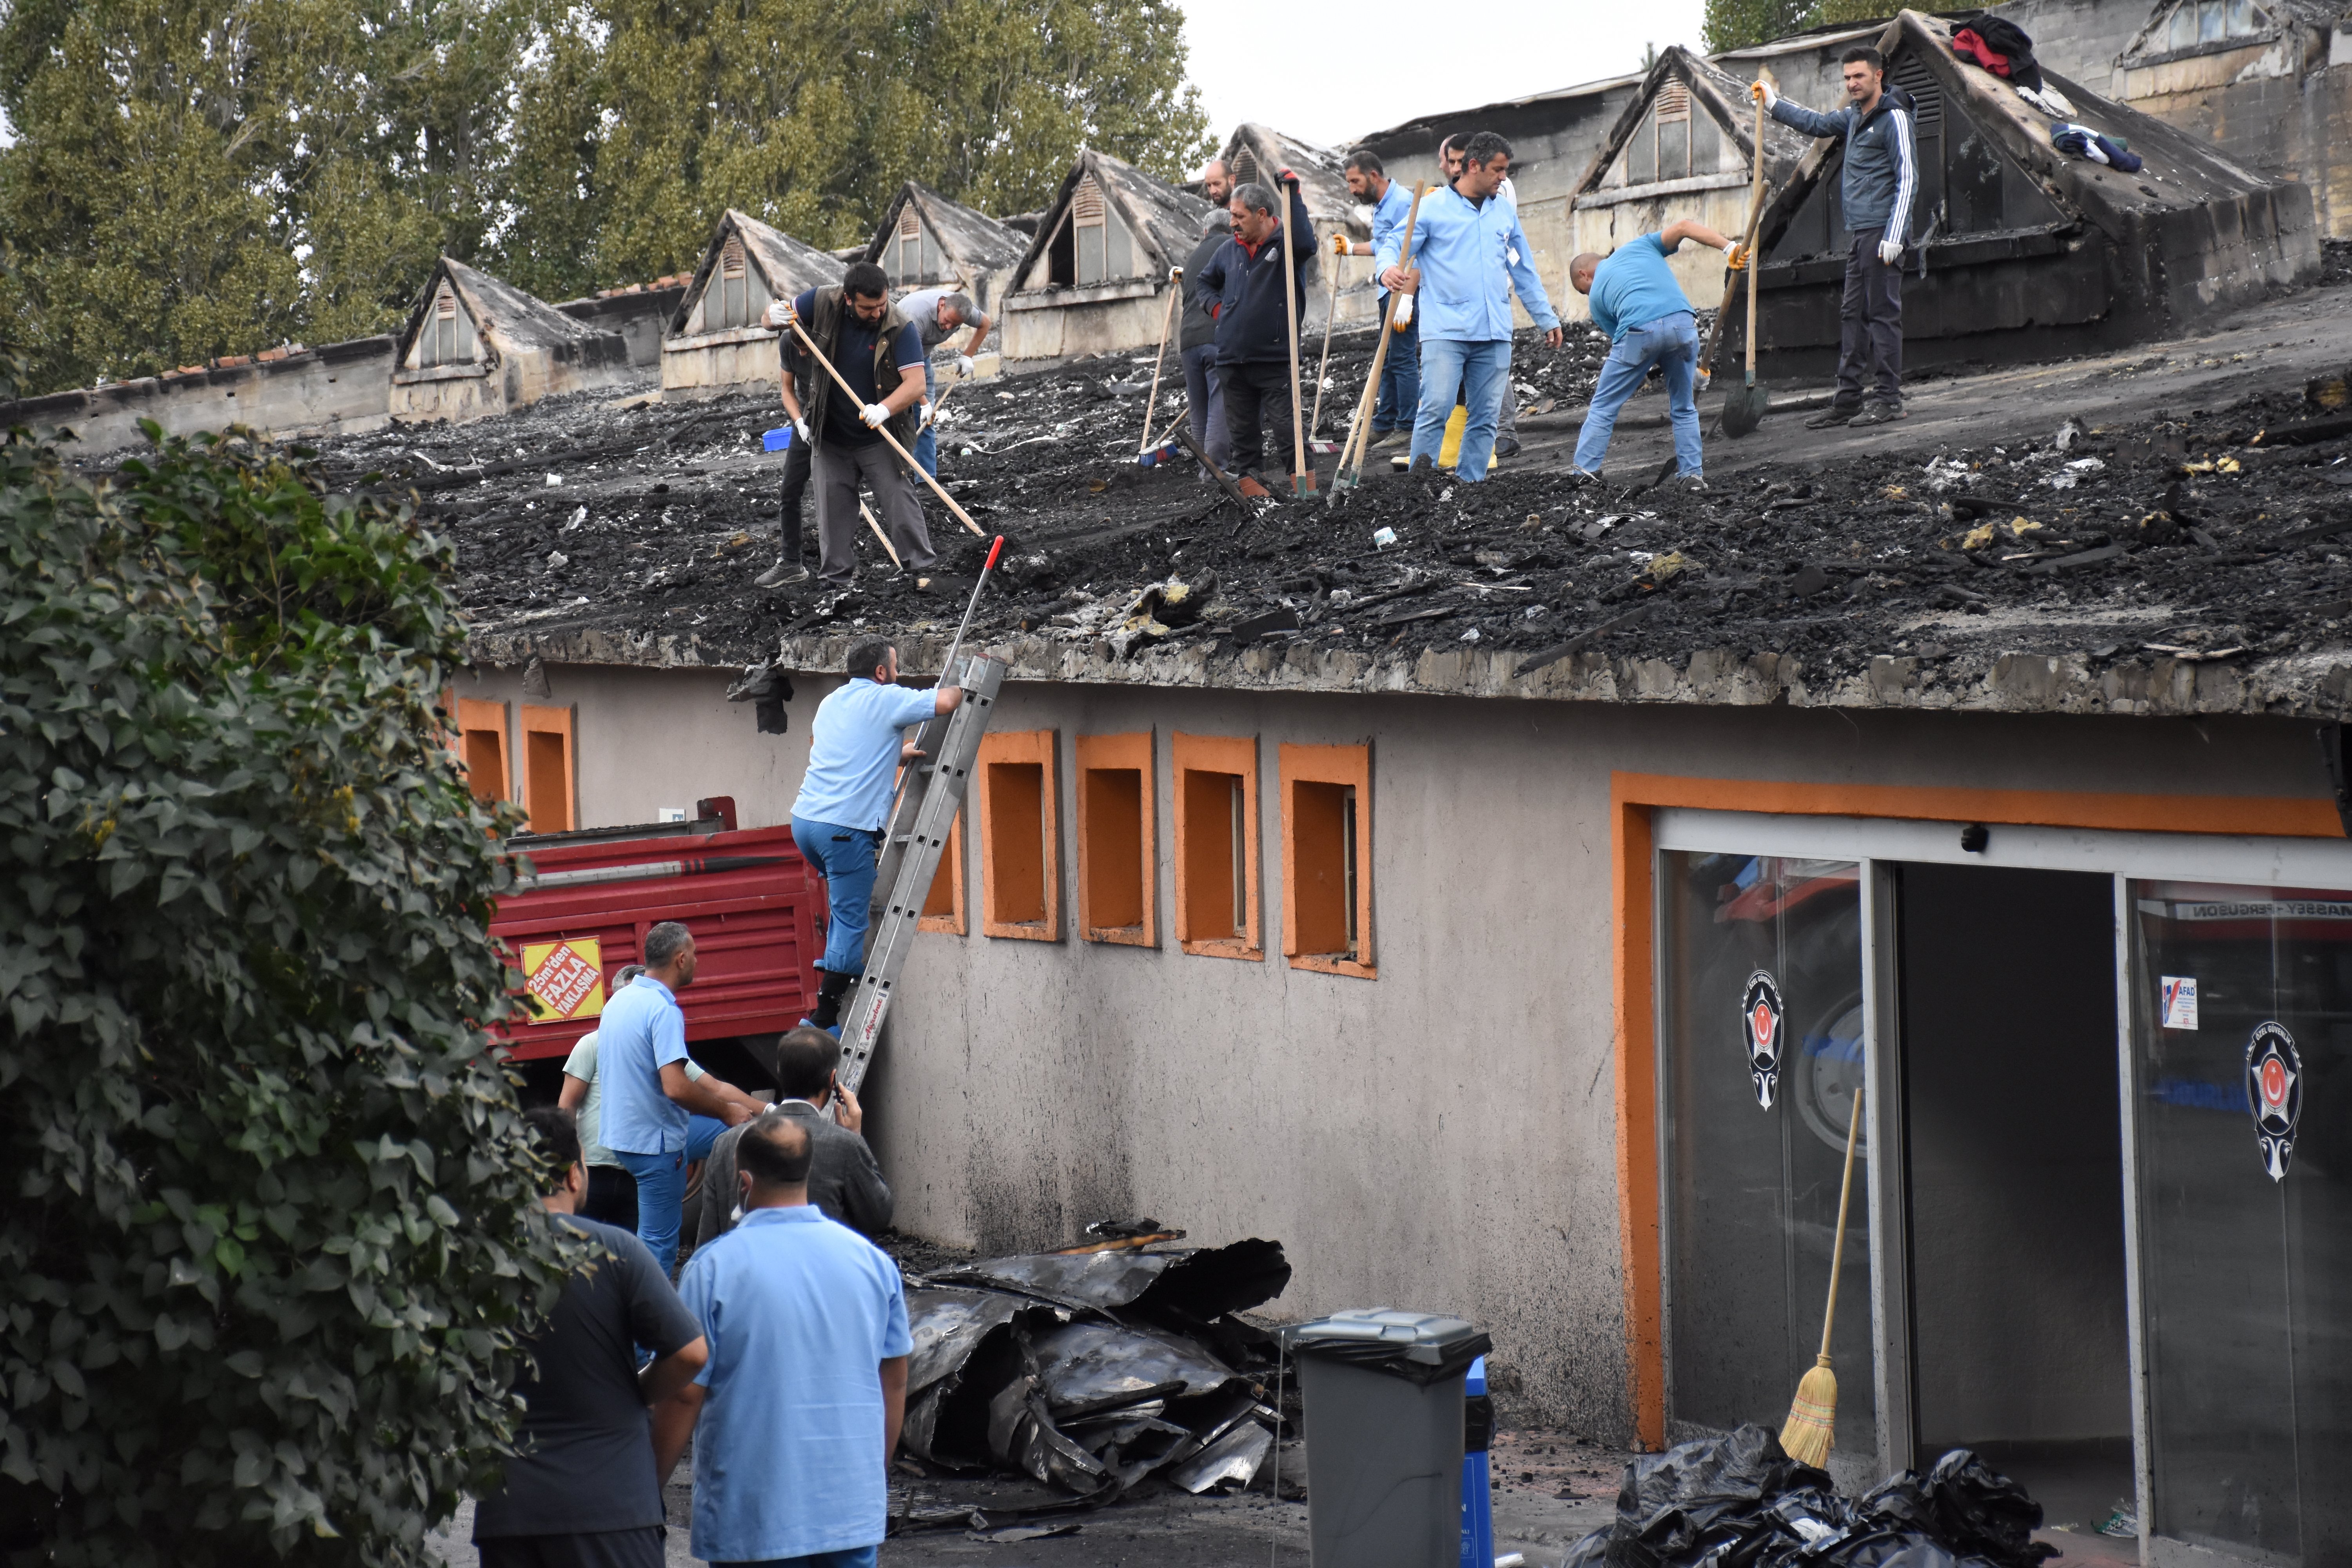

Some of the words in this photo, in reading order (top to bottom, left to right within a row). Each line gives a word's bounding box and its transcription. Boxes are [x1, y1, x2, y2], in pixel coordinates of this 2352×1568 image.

[540, 957, 586, 1006] FAZLA
[555, 968, 599, 1014] YAKLAŞMA
[1749, 977, 1758, 990] ÖZEL
[1758, 974, 1775, 992] GÜVENLİK
[2179, 986, 2195, 996] AFAD
[2256, 1027, 2267, 1040] ÖZEL
[2268, 1024, 2291, 1046] GÜVENLİK
